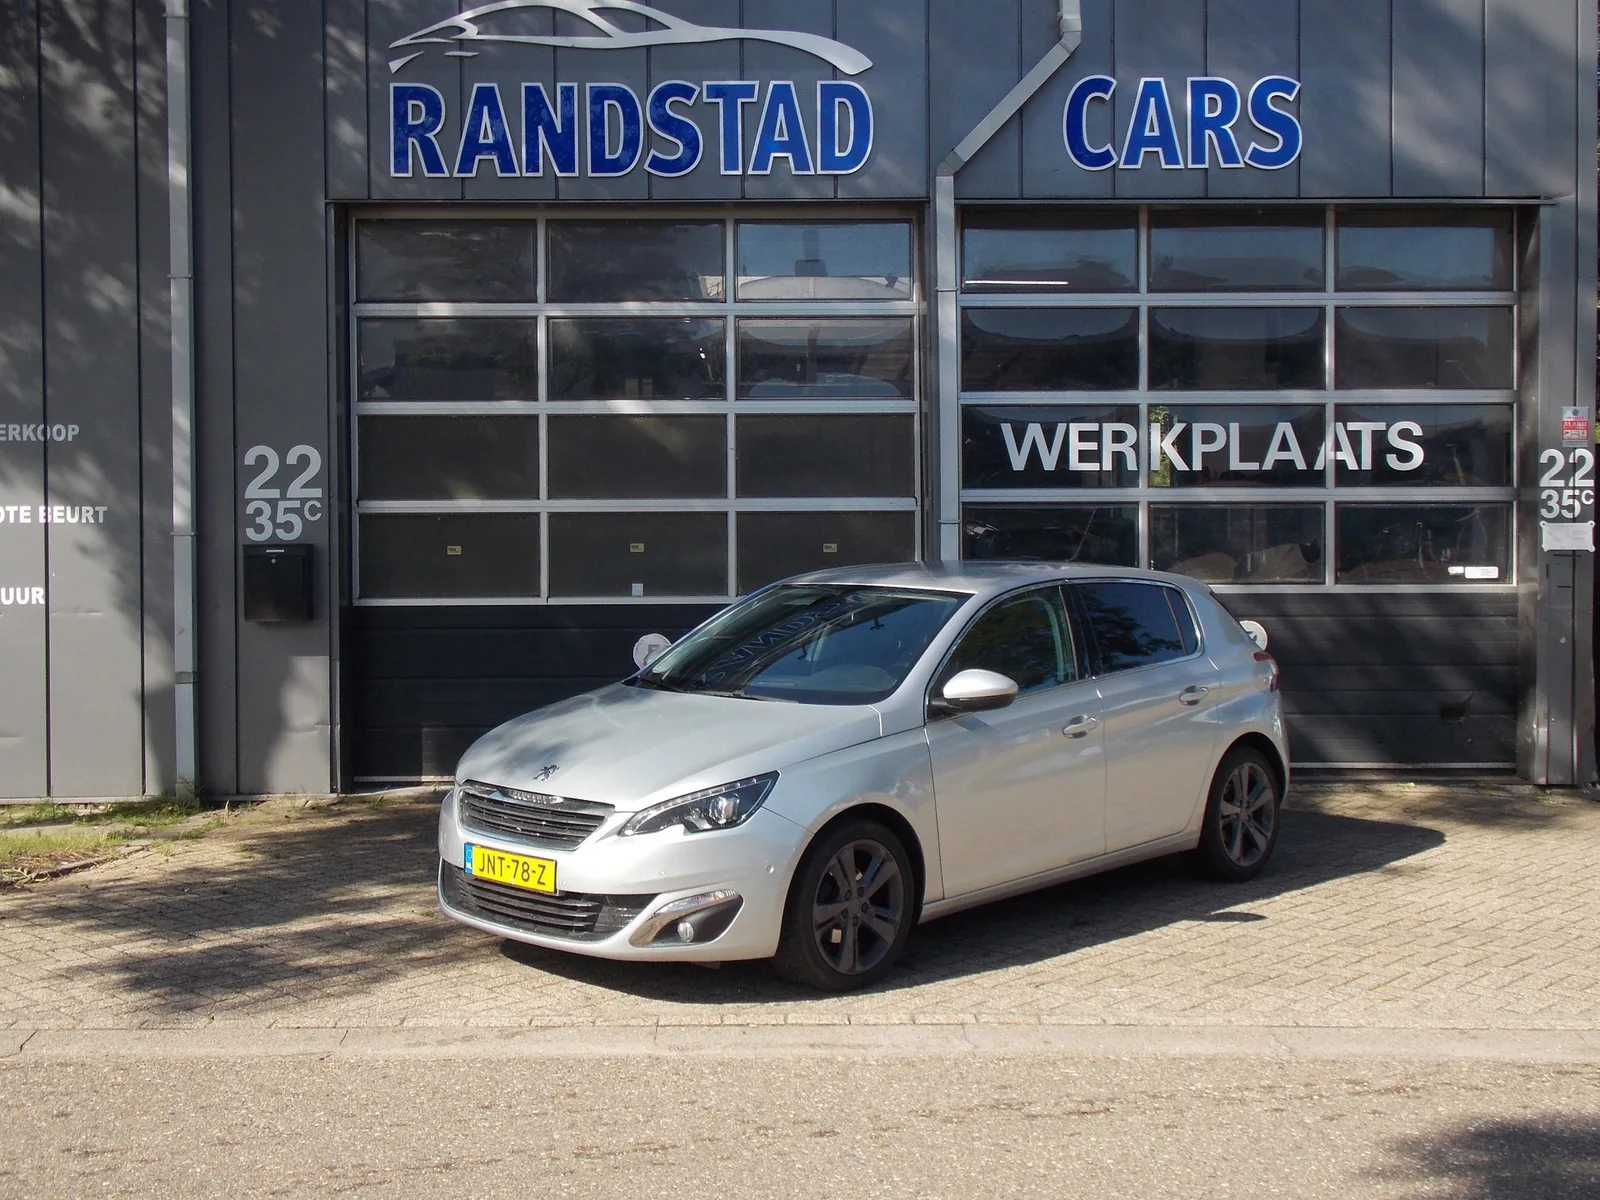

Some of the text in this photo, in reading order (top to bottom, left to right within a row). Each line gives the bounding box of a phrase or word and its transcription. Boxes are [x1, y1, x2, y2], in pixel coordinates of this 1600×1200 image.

[389, 75, 1303, 178] RANDSTAD CARS
[1000, 421, 1425, 471] WERKPLAATS
[1539, 449, 1595, 487] 22
[244, 445, 322, 499] 22
[39, 506, 107, 523] BEURT
[478, 853, 547, 886] JNT-78-Z
